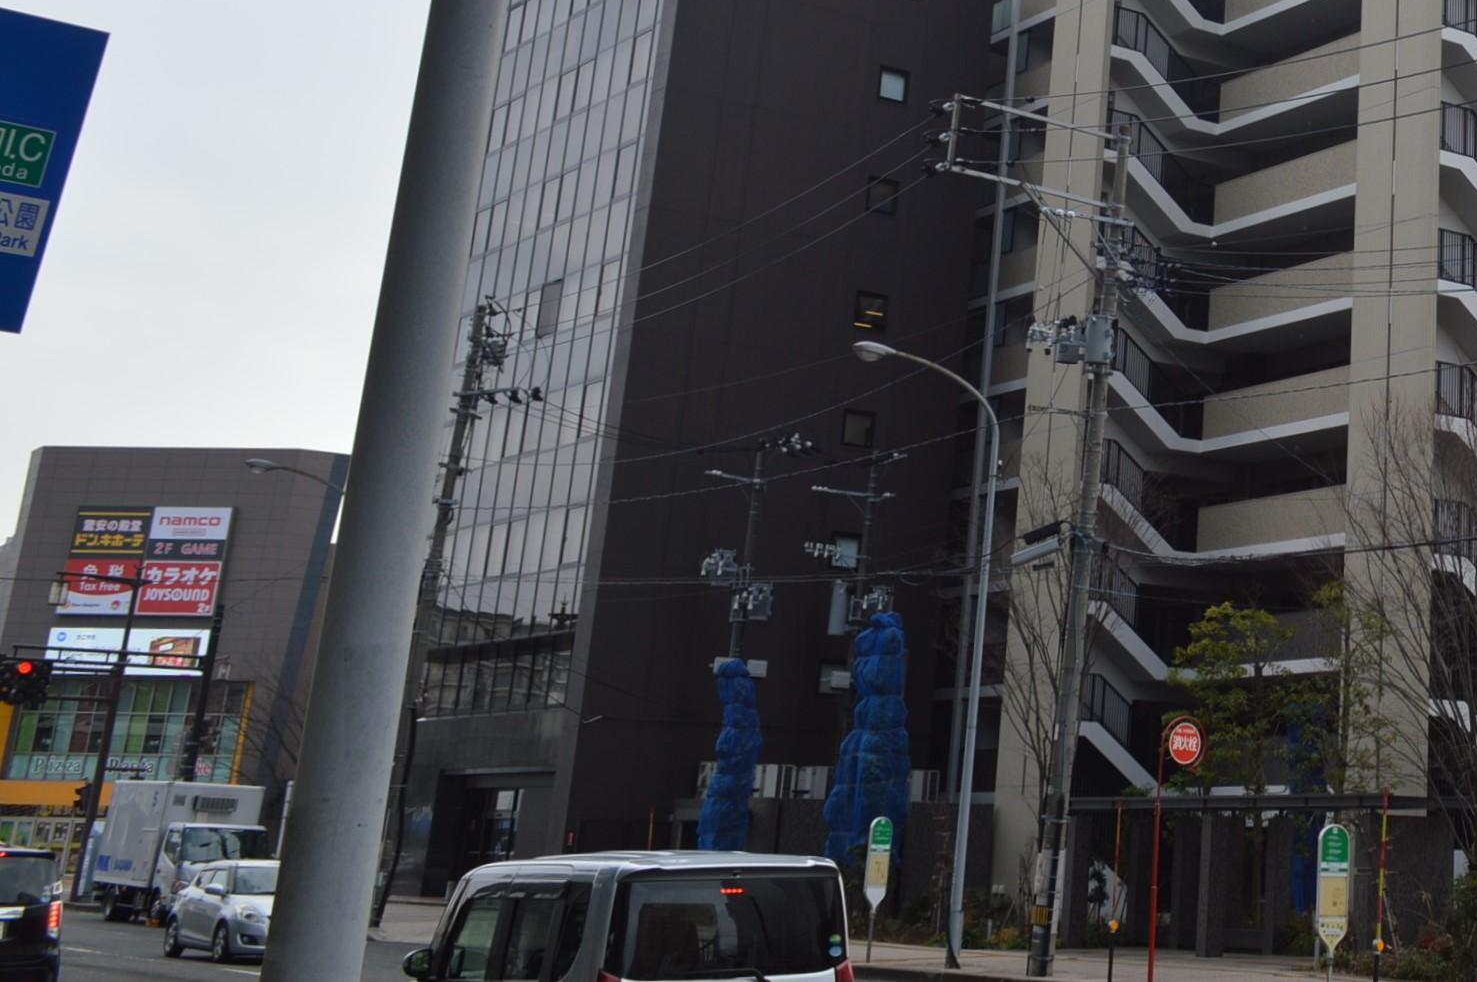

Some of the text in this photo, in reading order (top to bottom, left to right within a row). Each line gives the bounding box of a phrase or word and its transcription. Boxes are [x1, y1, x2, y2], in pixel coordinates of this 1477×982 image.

[159, 515, 222, 527] namco
[153, 542, 219, 556] 2F GAME
[145, 566, 217, 586] カラオケ
[79, 581, 121, 593] Tax Free
[142, 589, 210, 602] JOYSOUND
[1172, 735, 1198, 752] 消火栓
[30, 755, 83, 775] Pizza
